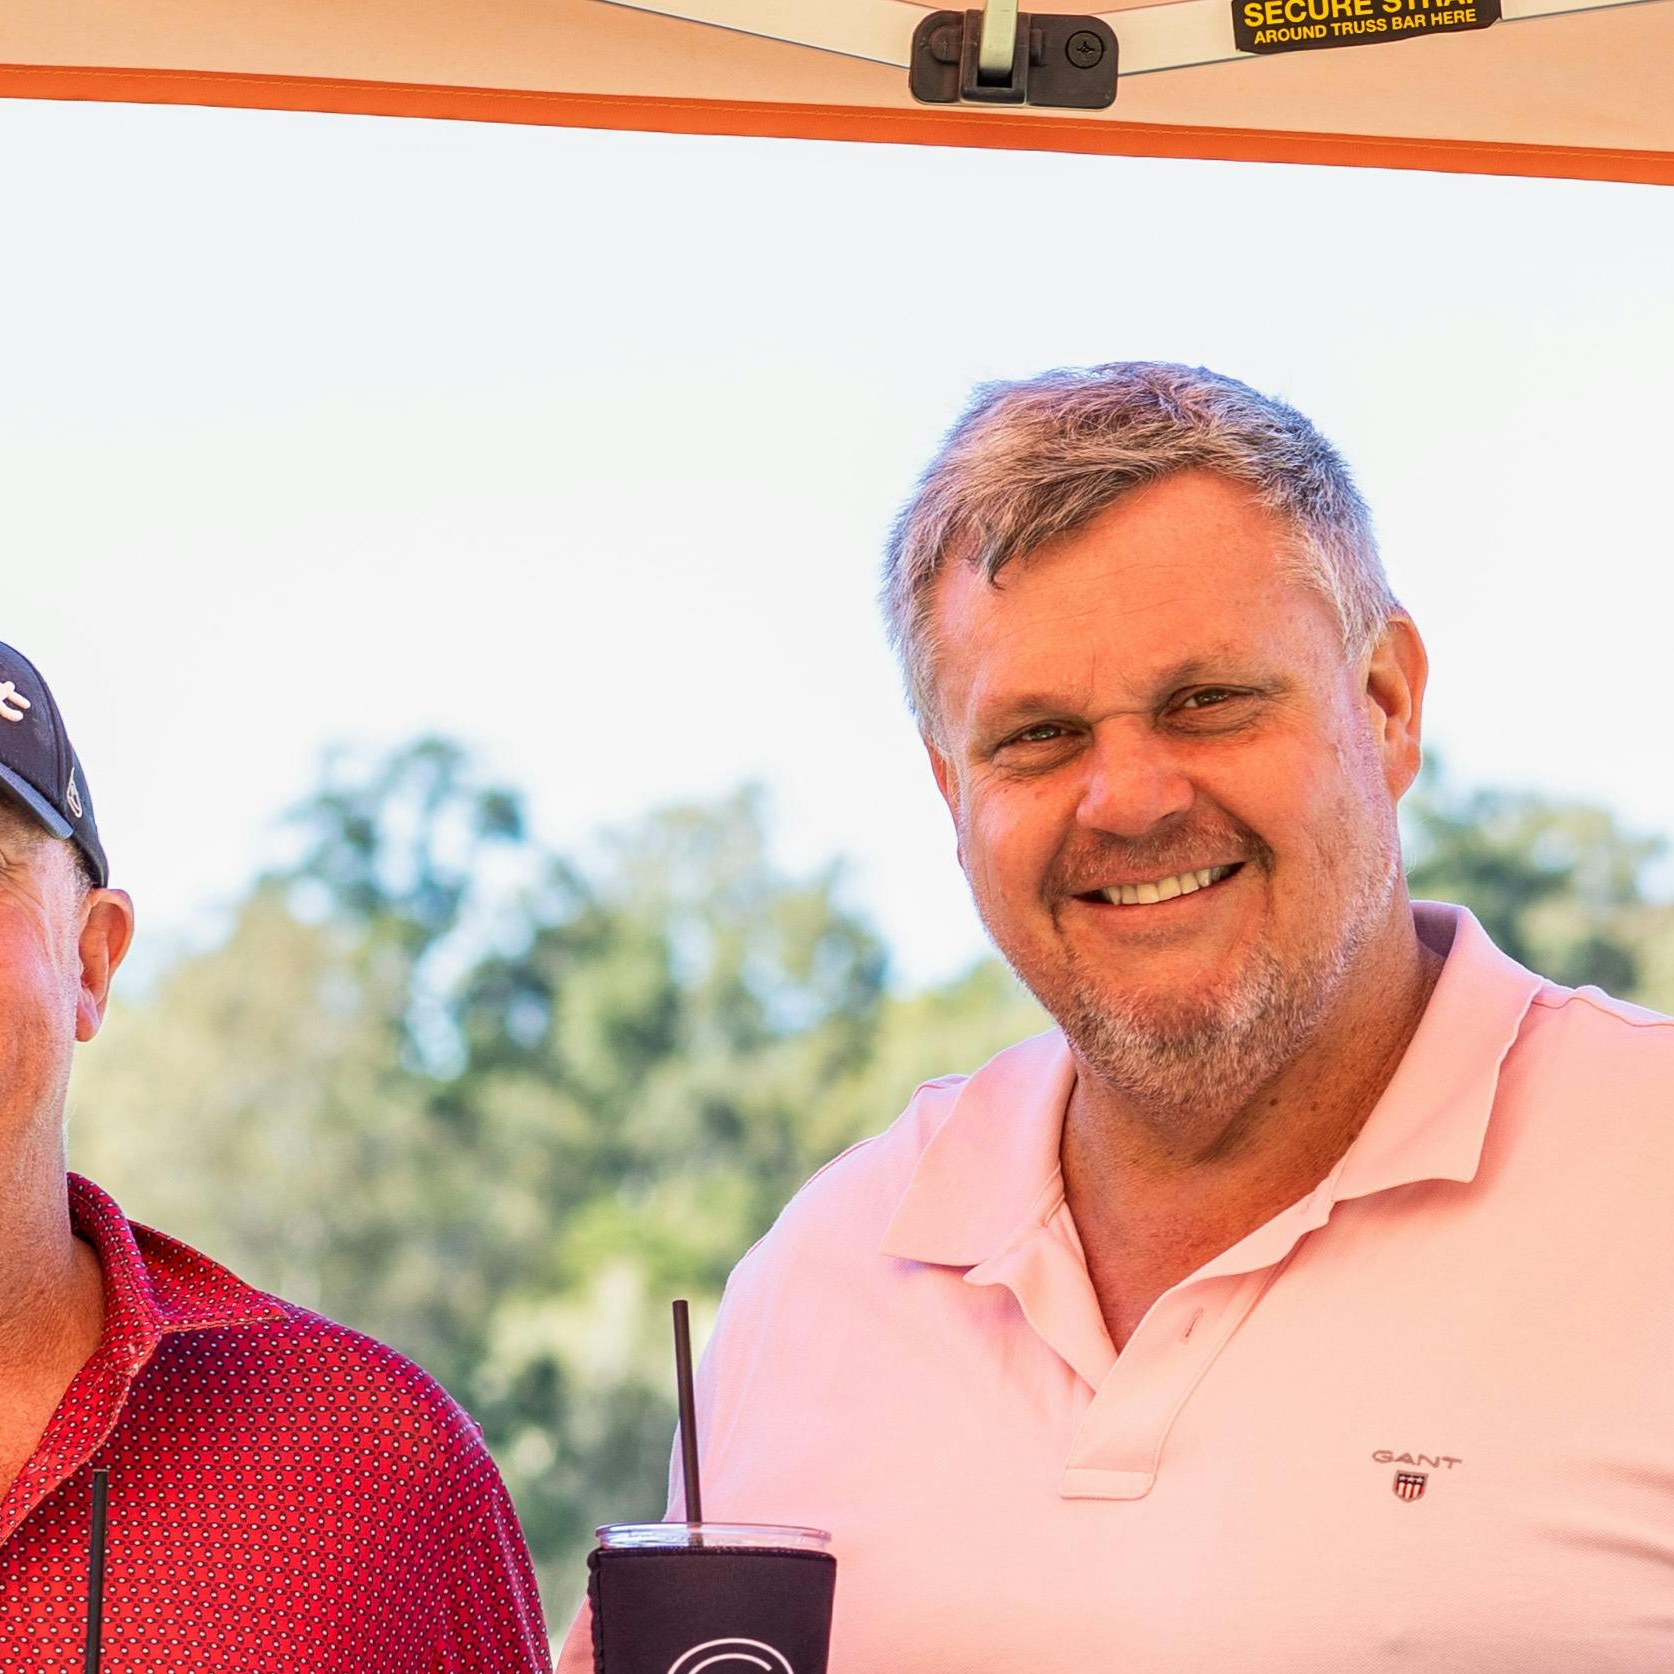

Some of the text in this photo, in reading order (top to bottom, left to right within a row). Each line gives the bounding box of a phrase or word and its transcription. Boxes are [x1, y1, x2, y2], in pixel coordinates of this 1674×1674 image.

[1243, 0, 1374, 28] SECURE
[1254, 9, 1477, 45] AROUND TRUSS BAR HERE
[1371, 1449, 1463, 1469] GANT
